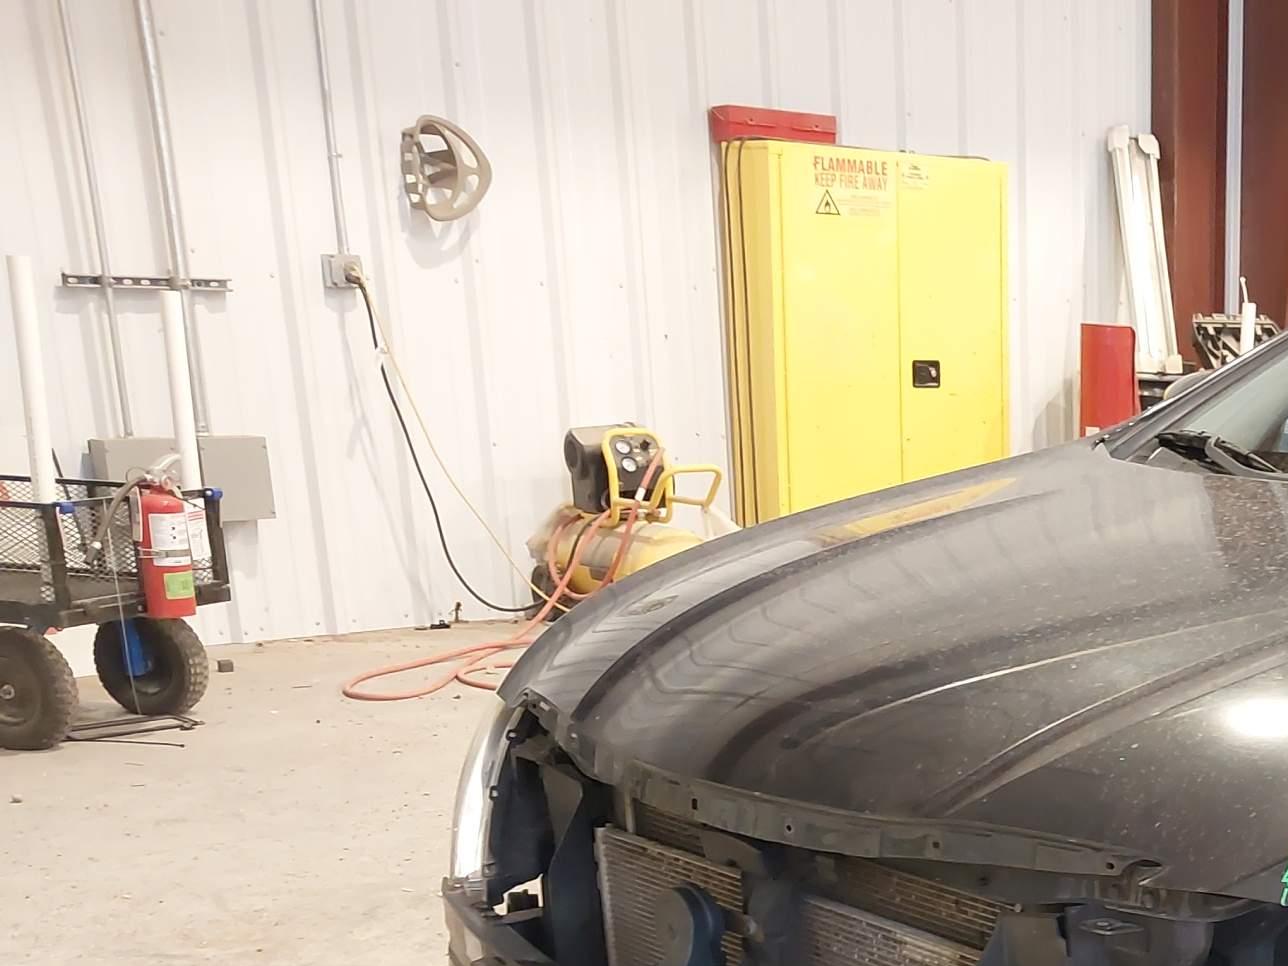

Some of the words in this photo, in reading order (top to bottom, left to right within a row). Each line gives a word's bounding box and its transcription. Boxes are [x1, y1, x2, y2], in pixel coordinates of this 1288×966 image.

[813, 156, 888, 176] FLAMMABLE
[815, 173, 836, 187] KEEP
[840, 174, 859, 189] FIRE
[862, 176, 888, 191] AWAY
